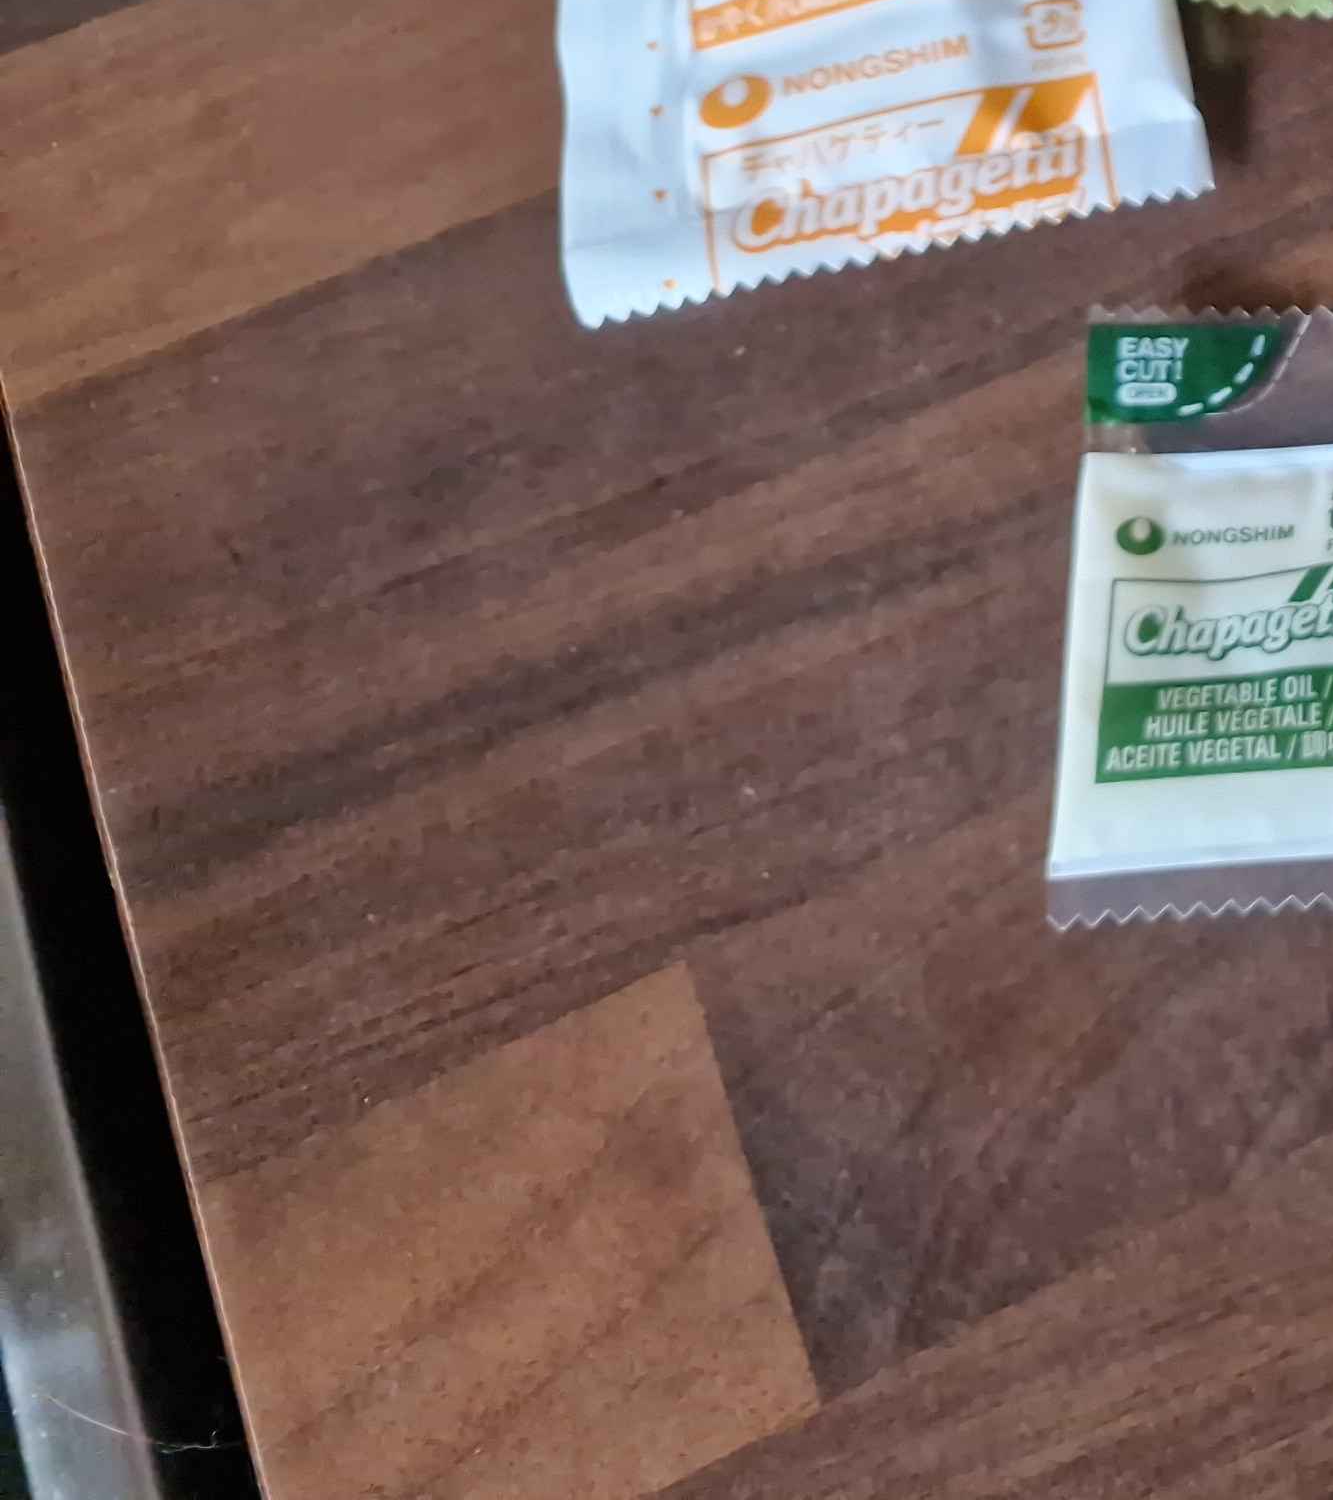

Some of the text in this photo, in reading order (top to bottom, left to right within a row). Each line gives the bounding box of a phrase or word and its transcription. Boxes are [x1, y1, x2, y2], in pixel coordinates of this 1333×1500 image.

[782, 34, 971, 97] NONGSHIM
[733, 124, 1086, 254] Chapagetti
[1117, 336, 1189, 359] EASY
[1117, 359, 1184, 382] CUT!
[1172, 524, 1296, 548] NONGSHIM
[1157, 677, 1278, 711] VEGETABLE
[1283, 673, 1319, 700] OIL
[1144, 711, 1210, 740] HUILE
[1105, 742, 1183, 773] ACEITE
[1187, 733, 1282, 769] VEGETAL
